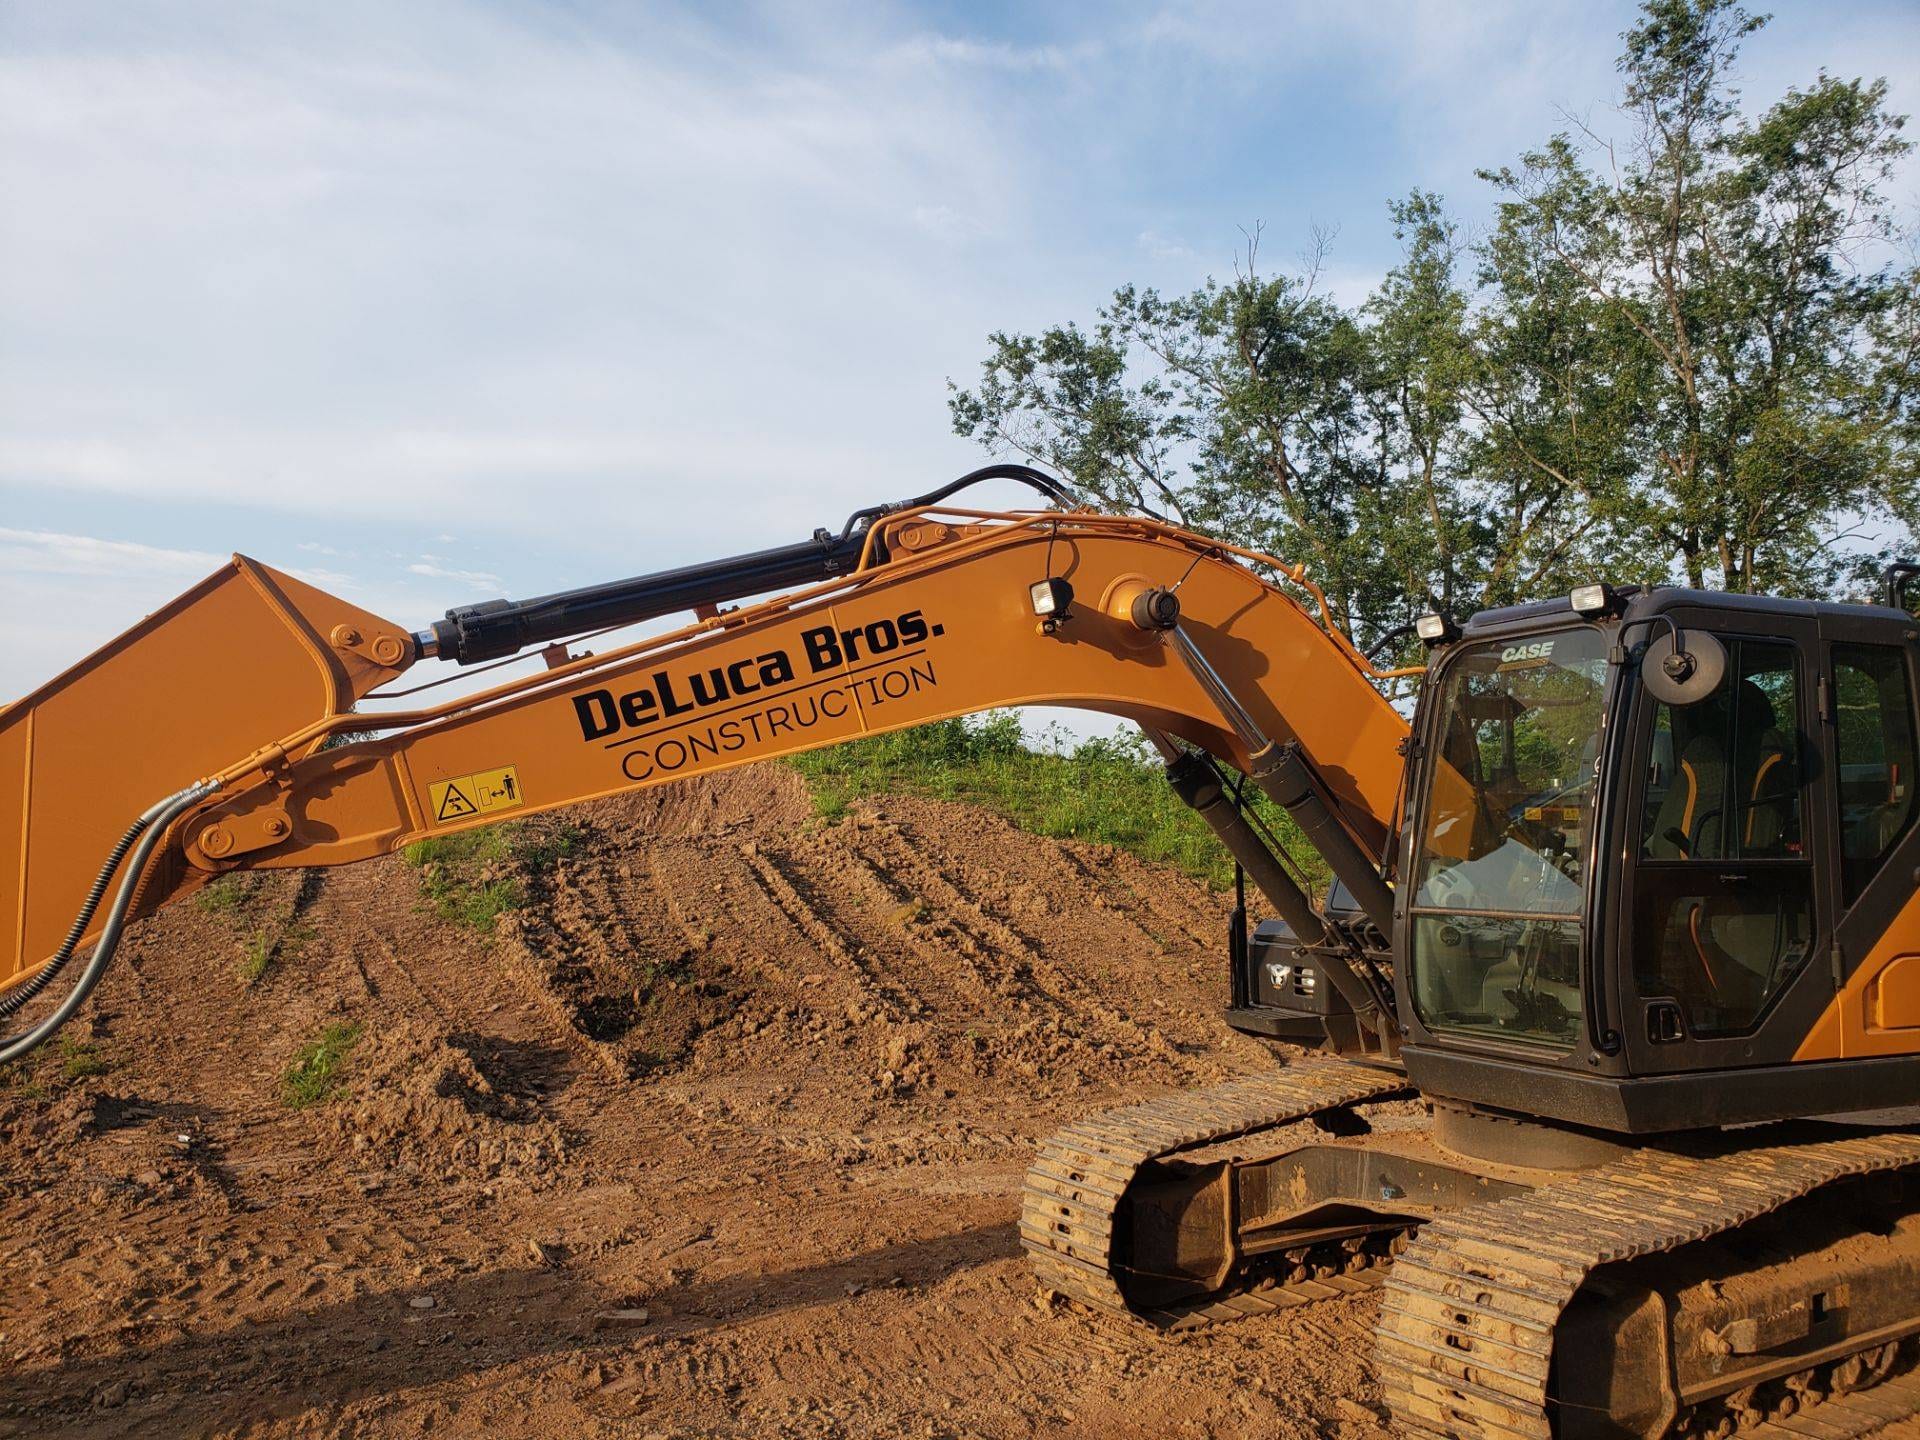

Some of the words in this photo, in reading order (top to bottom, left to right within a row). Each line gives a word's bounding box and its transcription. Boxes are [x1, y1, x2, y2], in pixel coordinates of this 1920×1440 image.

[572, 650, 796, 742] DeLuca
[801, 609, 945, 674] Bros.
[1502, 641, 1555, 662] CASE
[622, 660, 937, 781] CONSTRUCTION
